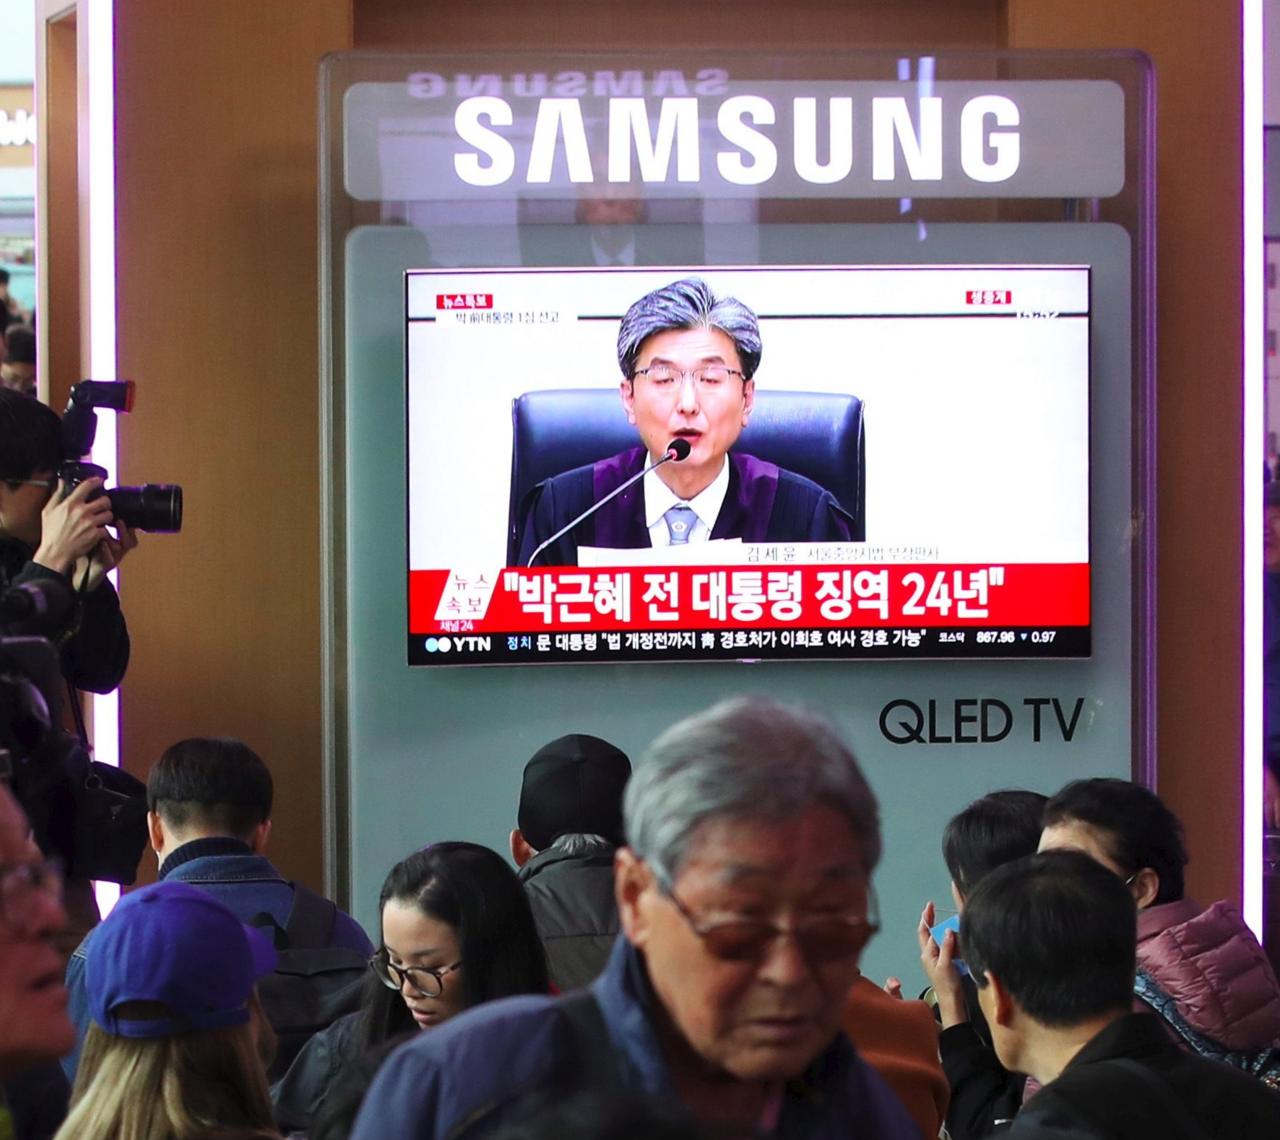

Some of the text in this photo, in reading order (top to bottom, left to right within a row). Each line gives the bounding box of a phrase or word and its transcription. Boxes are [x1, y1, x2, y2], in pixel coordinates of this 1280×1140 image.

[454, 95, 1020, 186] SAMSUNG
[504, 567, 1005, 623] "박근혜 전 대통령 징역 24년"
[454, 637, 491, 651] YTN
[507, 636, 531, 650] 정치
[537, 633, 551, 650] 문
[555, 633, 597, 651] 대통령
[625, 632, 696, 650] 개정전까지
[720, 632, 776, 649] 경호처가
[780, 632, 822, 648] 이희호
[827, 632, 856, 648] 여사
[860, 631, 888, 647] 경호
[938, 631, 1056, 644] 코스닥 867.96 0.97
[879, 698, 1085, 744] QLED TV
